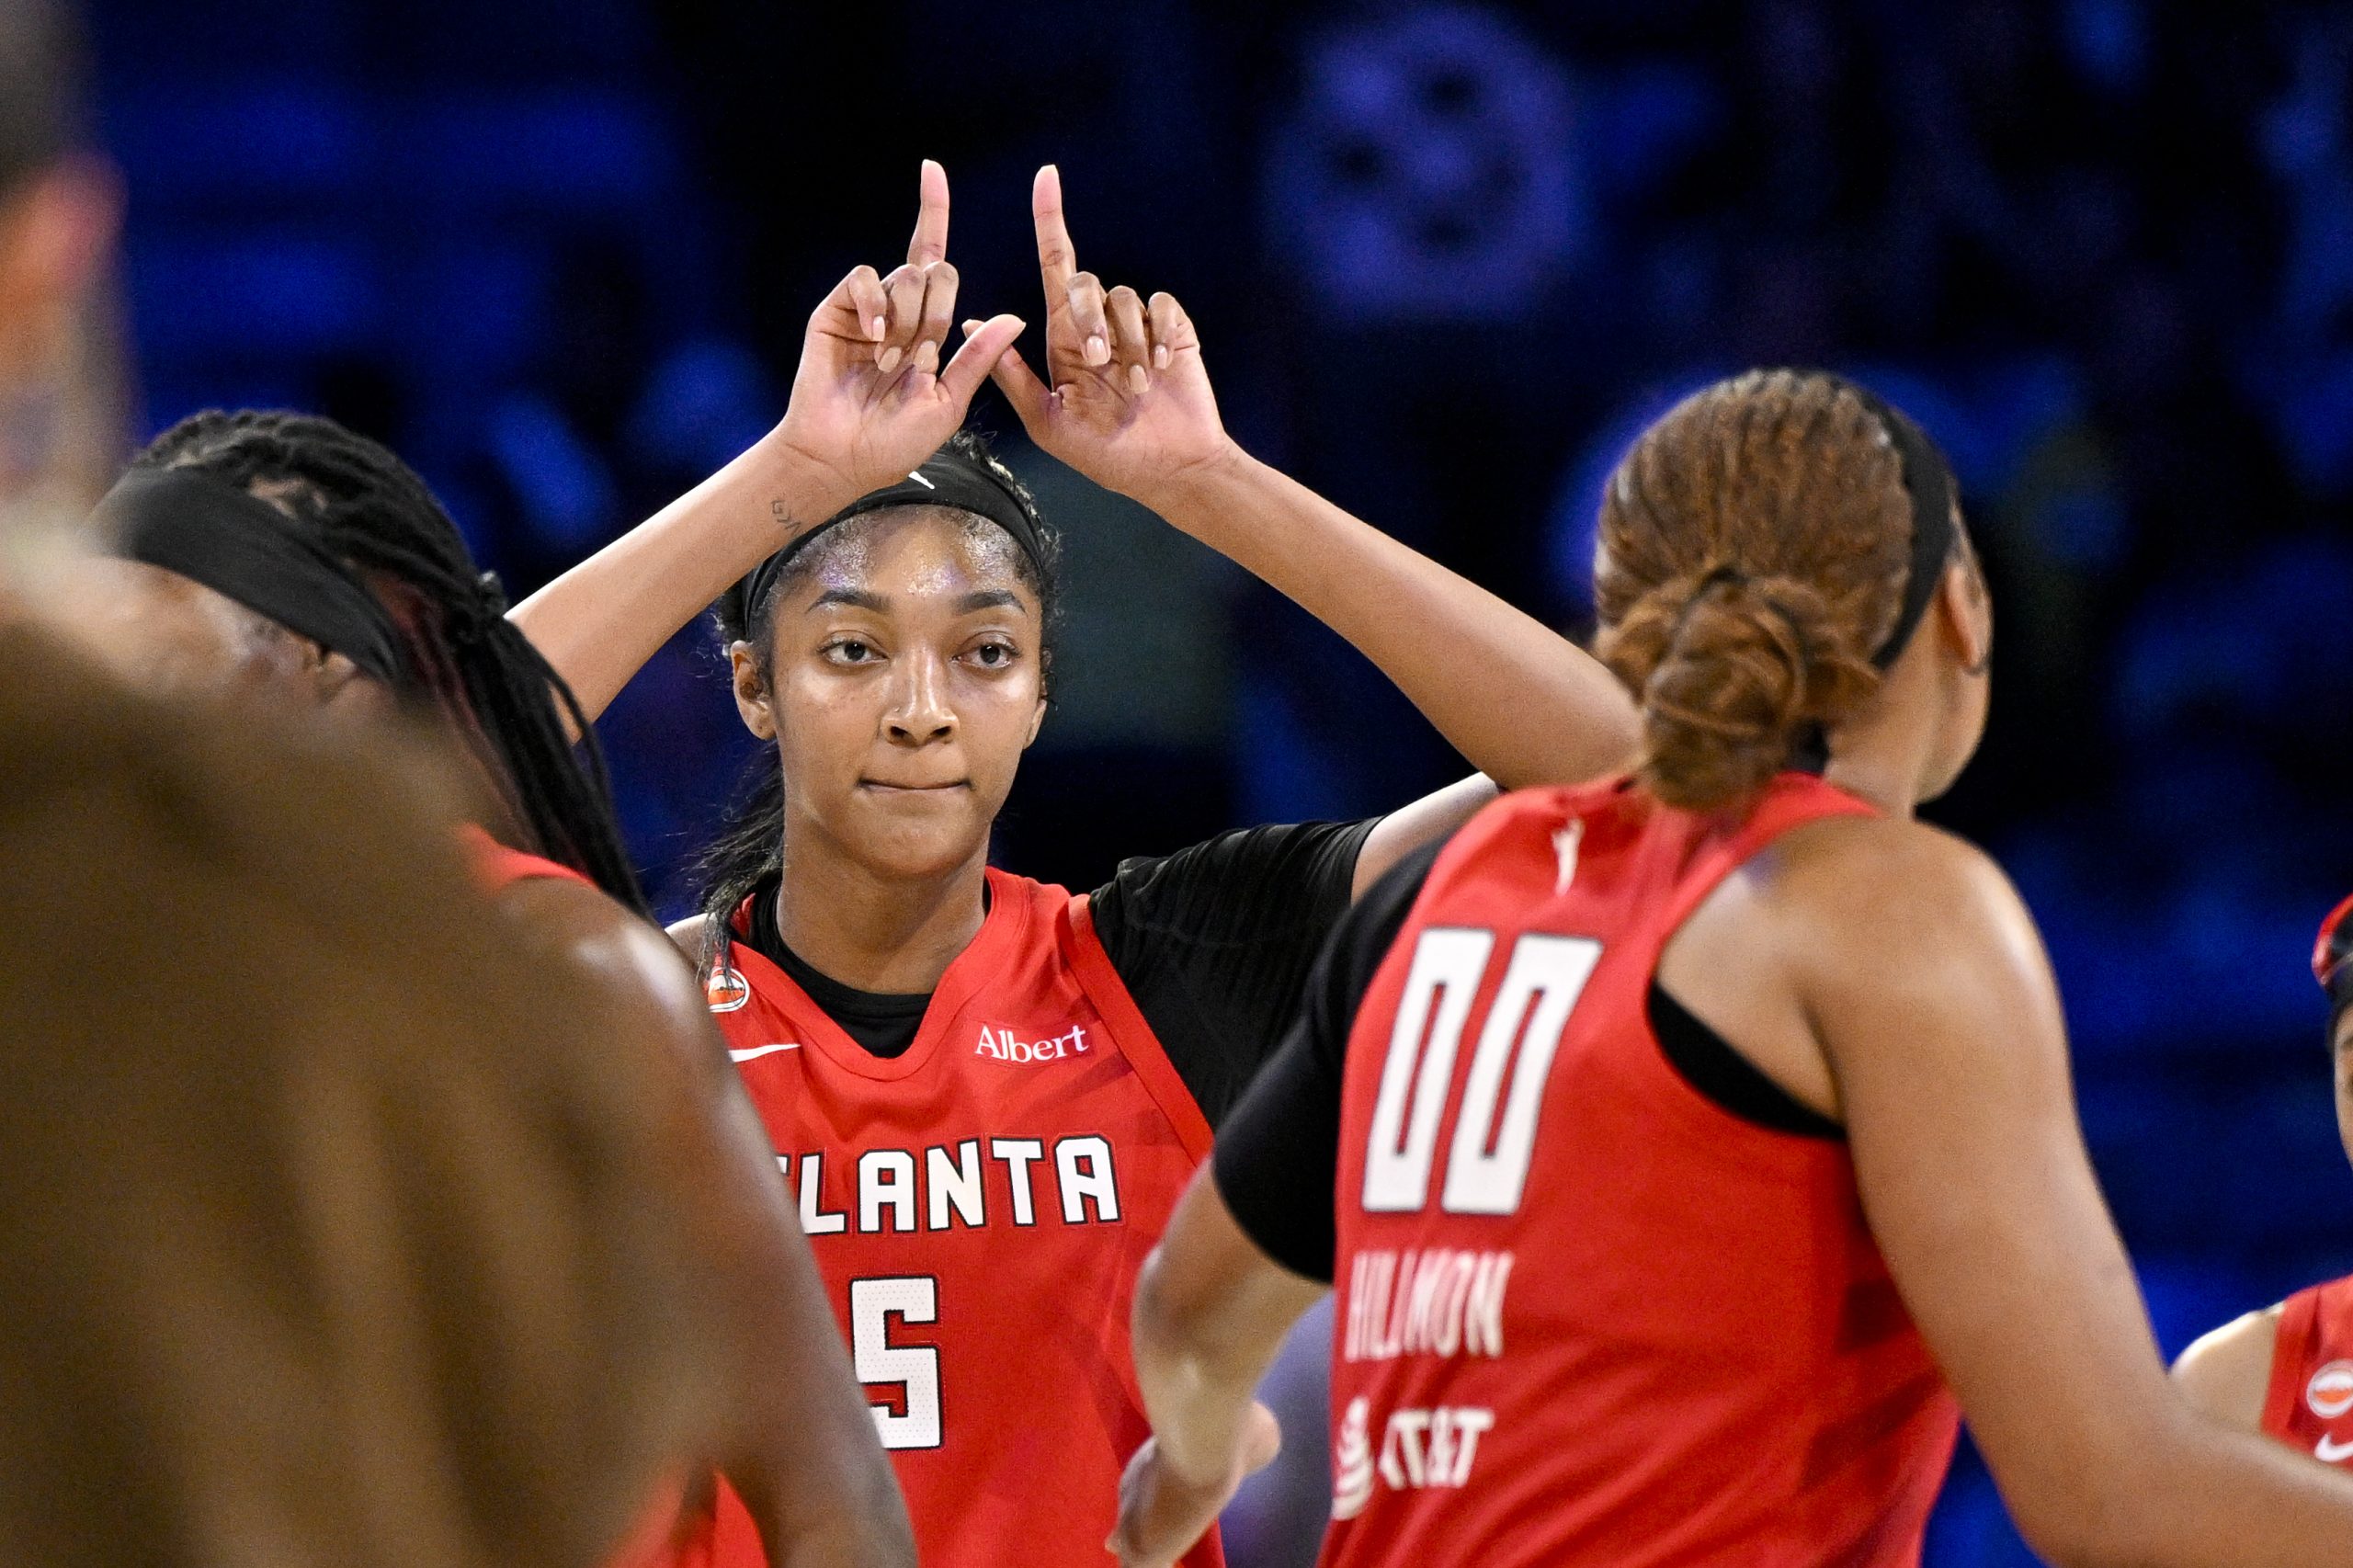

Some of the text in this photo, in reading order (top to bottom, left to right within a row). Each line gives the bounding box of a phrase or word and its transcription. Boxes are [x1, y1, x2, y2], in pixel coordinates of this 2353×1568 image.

[974, 1025, 1089, 1063] Albert
[1361, 926, 1604, 1216] 00
[778, 1133, 1120, 1235] LANTA
[849, 1276, 942, 1449] 5
